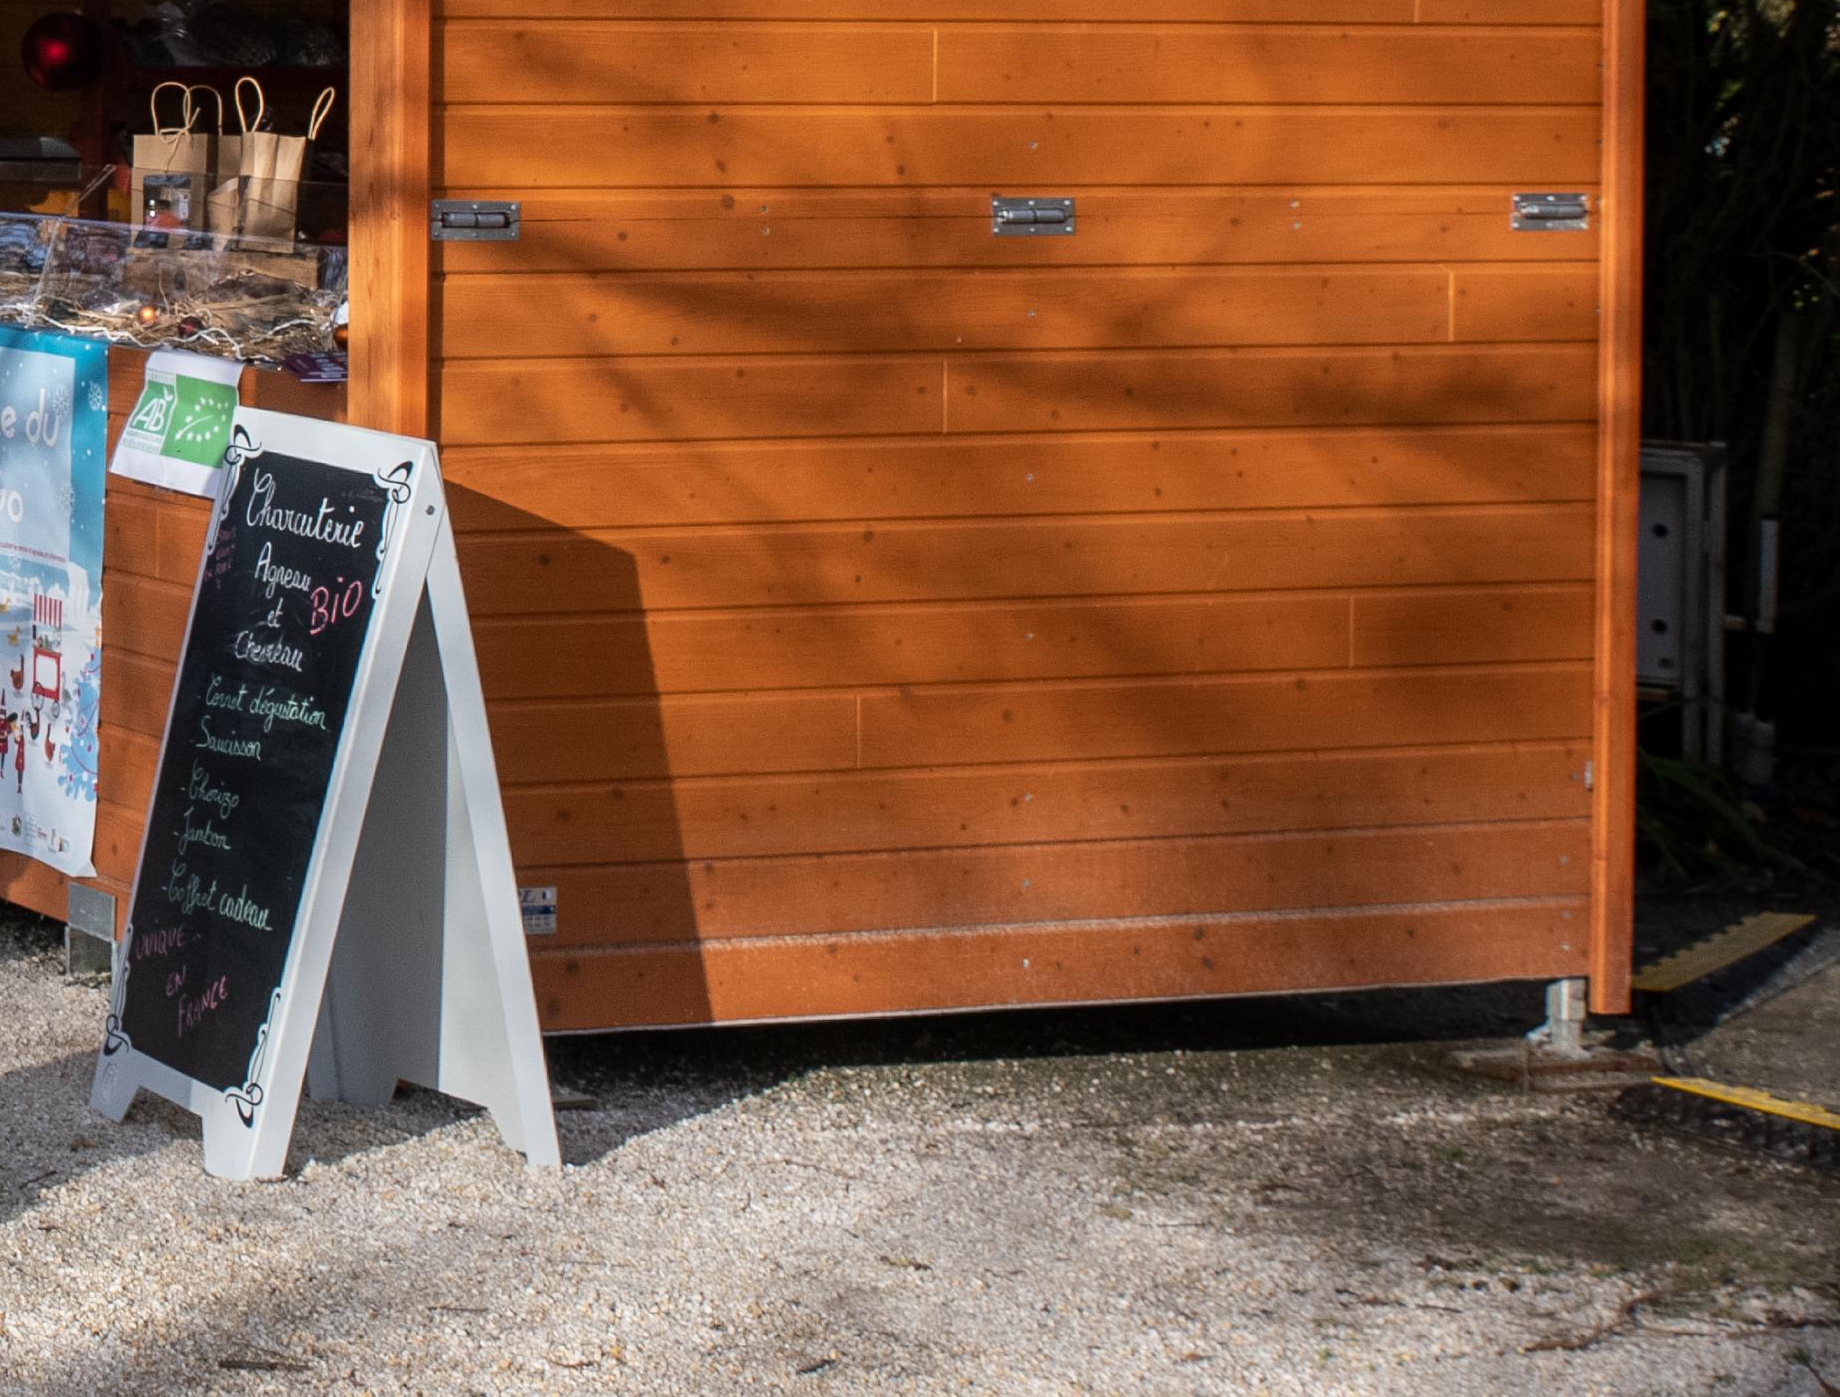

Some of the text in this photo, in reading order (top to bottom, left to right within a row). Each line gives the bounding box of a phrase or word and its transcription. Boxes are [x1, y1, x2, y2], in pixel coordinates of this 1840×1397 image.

[25, 387, 61, 448] du
[246, 466, 365, 549] Charcuterie
[253, 541, 312, 599] Agneau
[266, 596, 284, 629] et
[249, 685, 327, 734] dégustation
[195, 714, 262, 762] Saucisson
[189, 757, 240, 820] Chorizo
[178, 805, 232, 856] Jambon
[219, 883, 274, 932] cadeau
